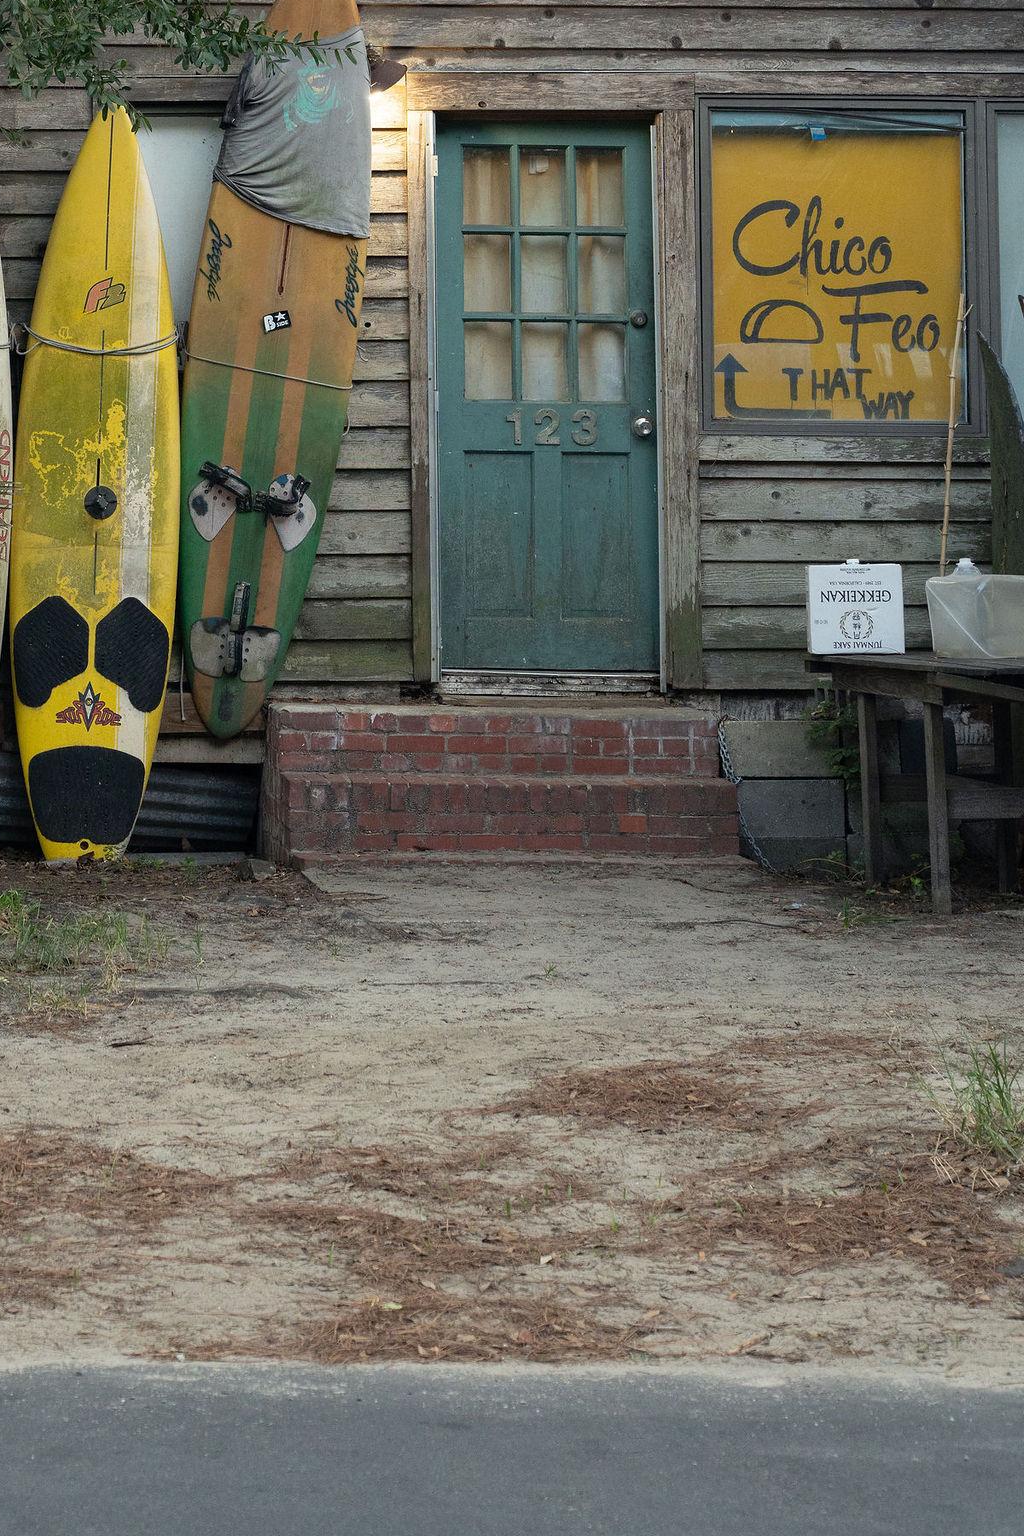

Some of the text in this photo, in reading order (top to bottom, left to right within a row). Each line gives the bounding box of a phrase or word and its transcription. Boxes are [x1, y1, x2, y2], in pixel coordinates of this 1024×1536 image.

[733, 195, 892, 276] Chico
[83, 277, 126, 314] F2
[264, 315, 276, 333] B
[821, 280, 940, 363] Feo
[782, 368, 915, 420] THAT WAY
[506, 407, 597, 446] 123
[821, 589, 892, 603] GEKKEIKAN
[833, 641, 882, 649] JUNMAI SAKE
